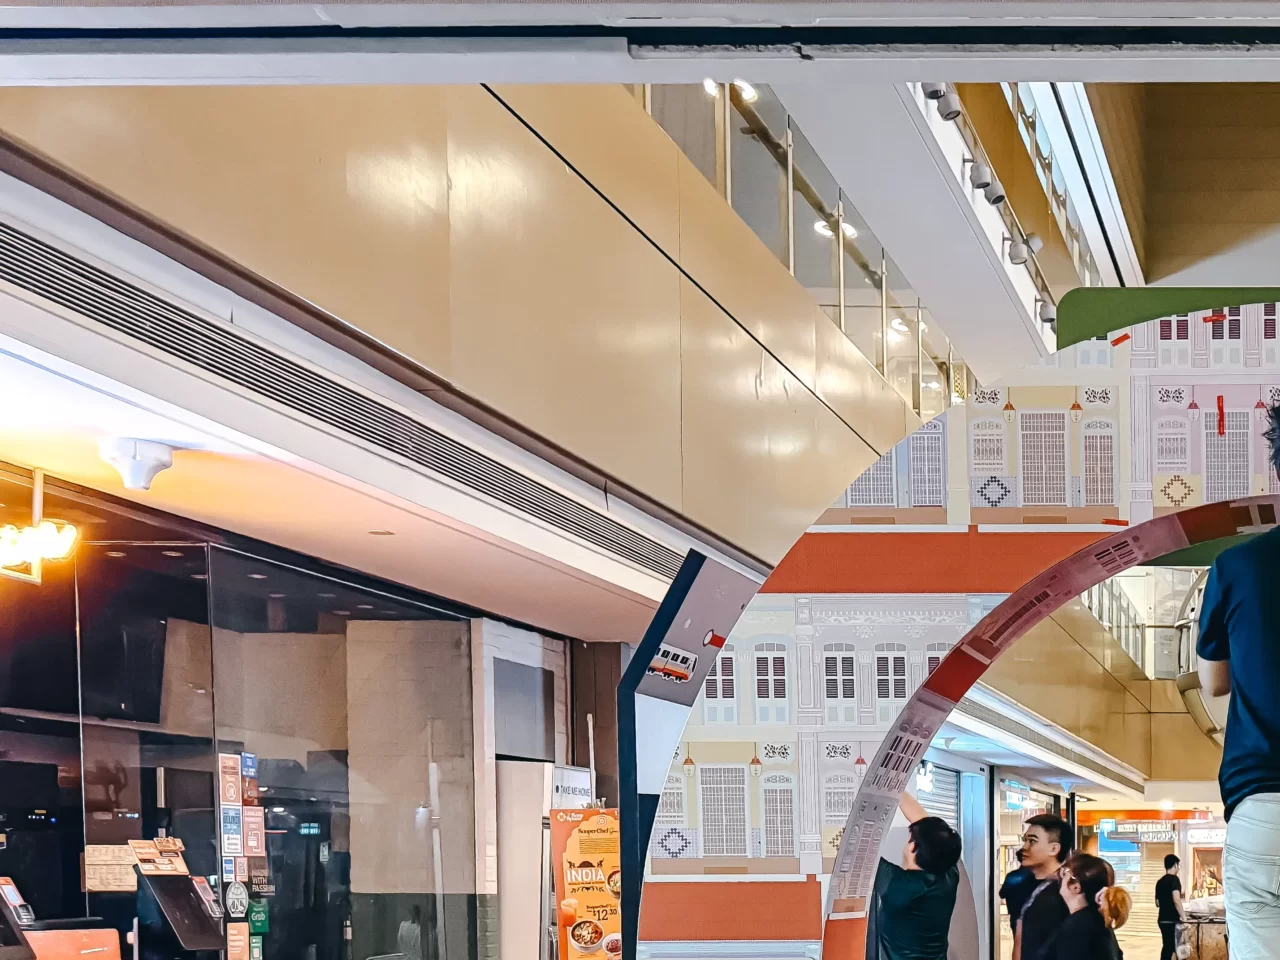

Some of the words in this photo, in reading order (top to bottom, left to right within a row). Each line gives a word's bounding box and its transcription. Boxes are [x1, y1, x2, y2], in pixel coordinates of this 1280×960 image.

[561, 785, 571, 795] TAKE
[571, 786, 578, 796] ME
[578, 788, 591, 797] HOME
[566, 868, 605, 882] INDIA
